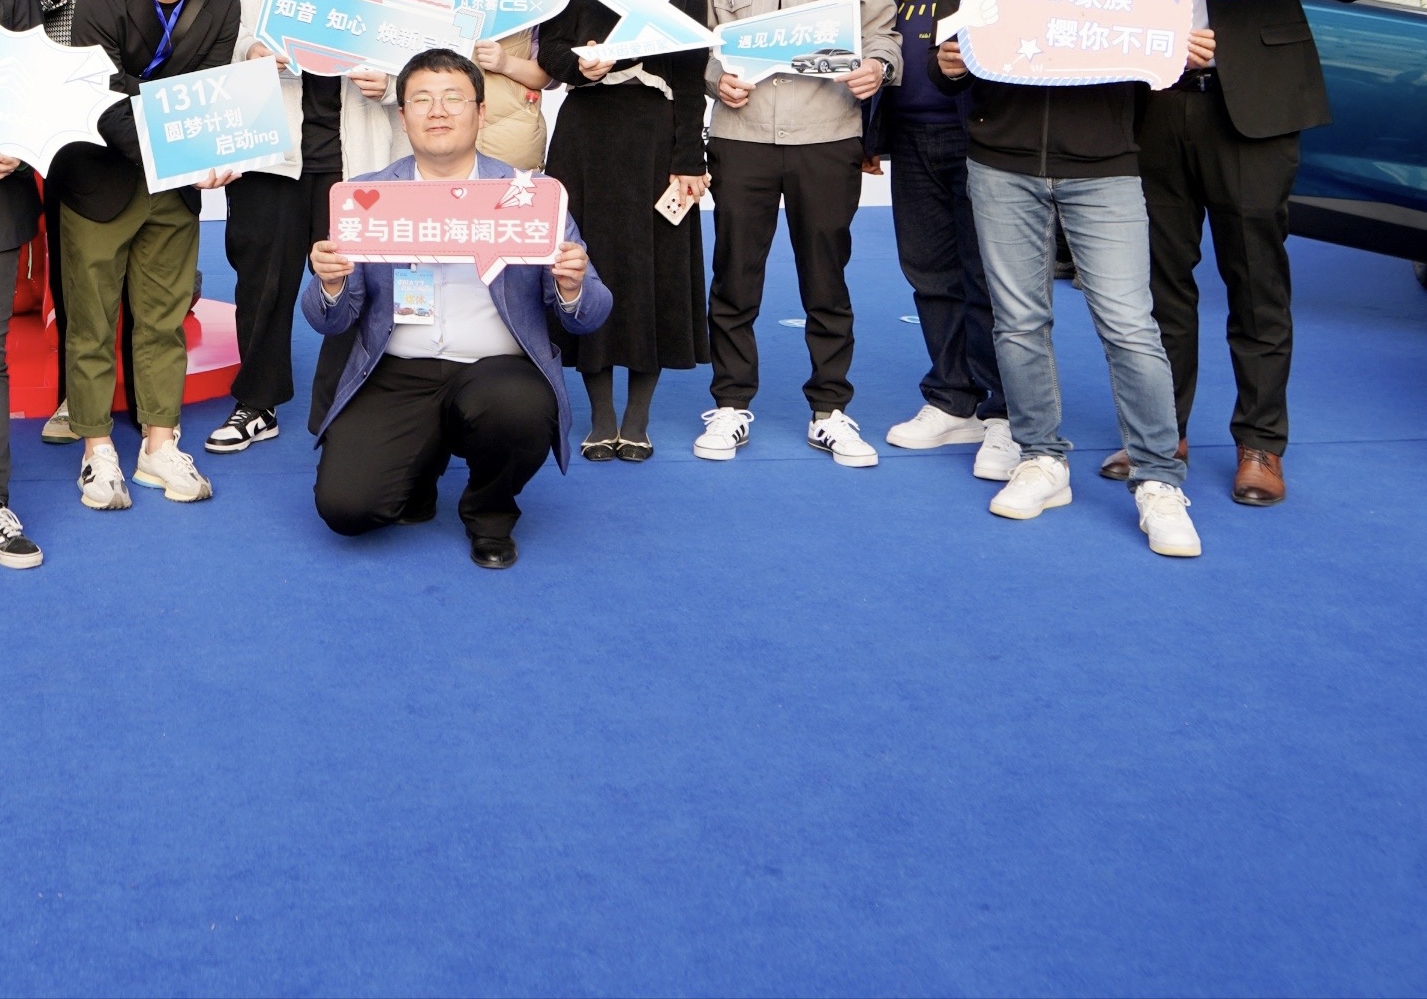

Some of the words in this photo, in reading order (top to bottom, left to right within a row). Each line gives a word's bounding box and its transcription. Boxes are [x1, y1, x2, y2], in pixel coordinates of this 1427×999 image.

[325, 9, 367, 36] 知心
[737, 19, 841, 50] 遇见凡尔赛
[1045, 17, 1175, 58] 樱你不同
[155, 74, 233, 114] 131X
[163, 107, 244, 143] 圆梦计划
[215, 127, 280, 156] 启动ing
[337, 217, 550, 244] 爱与自由海阔天空
